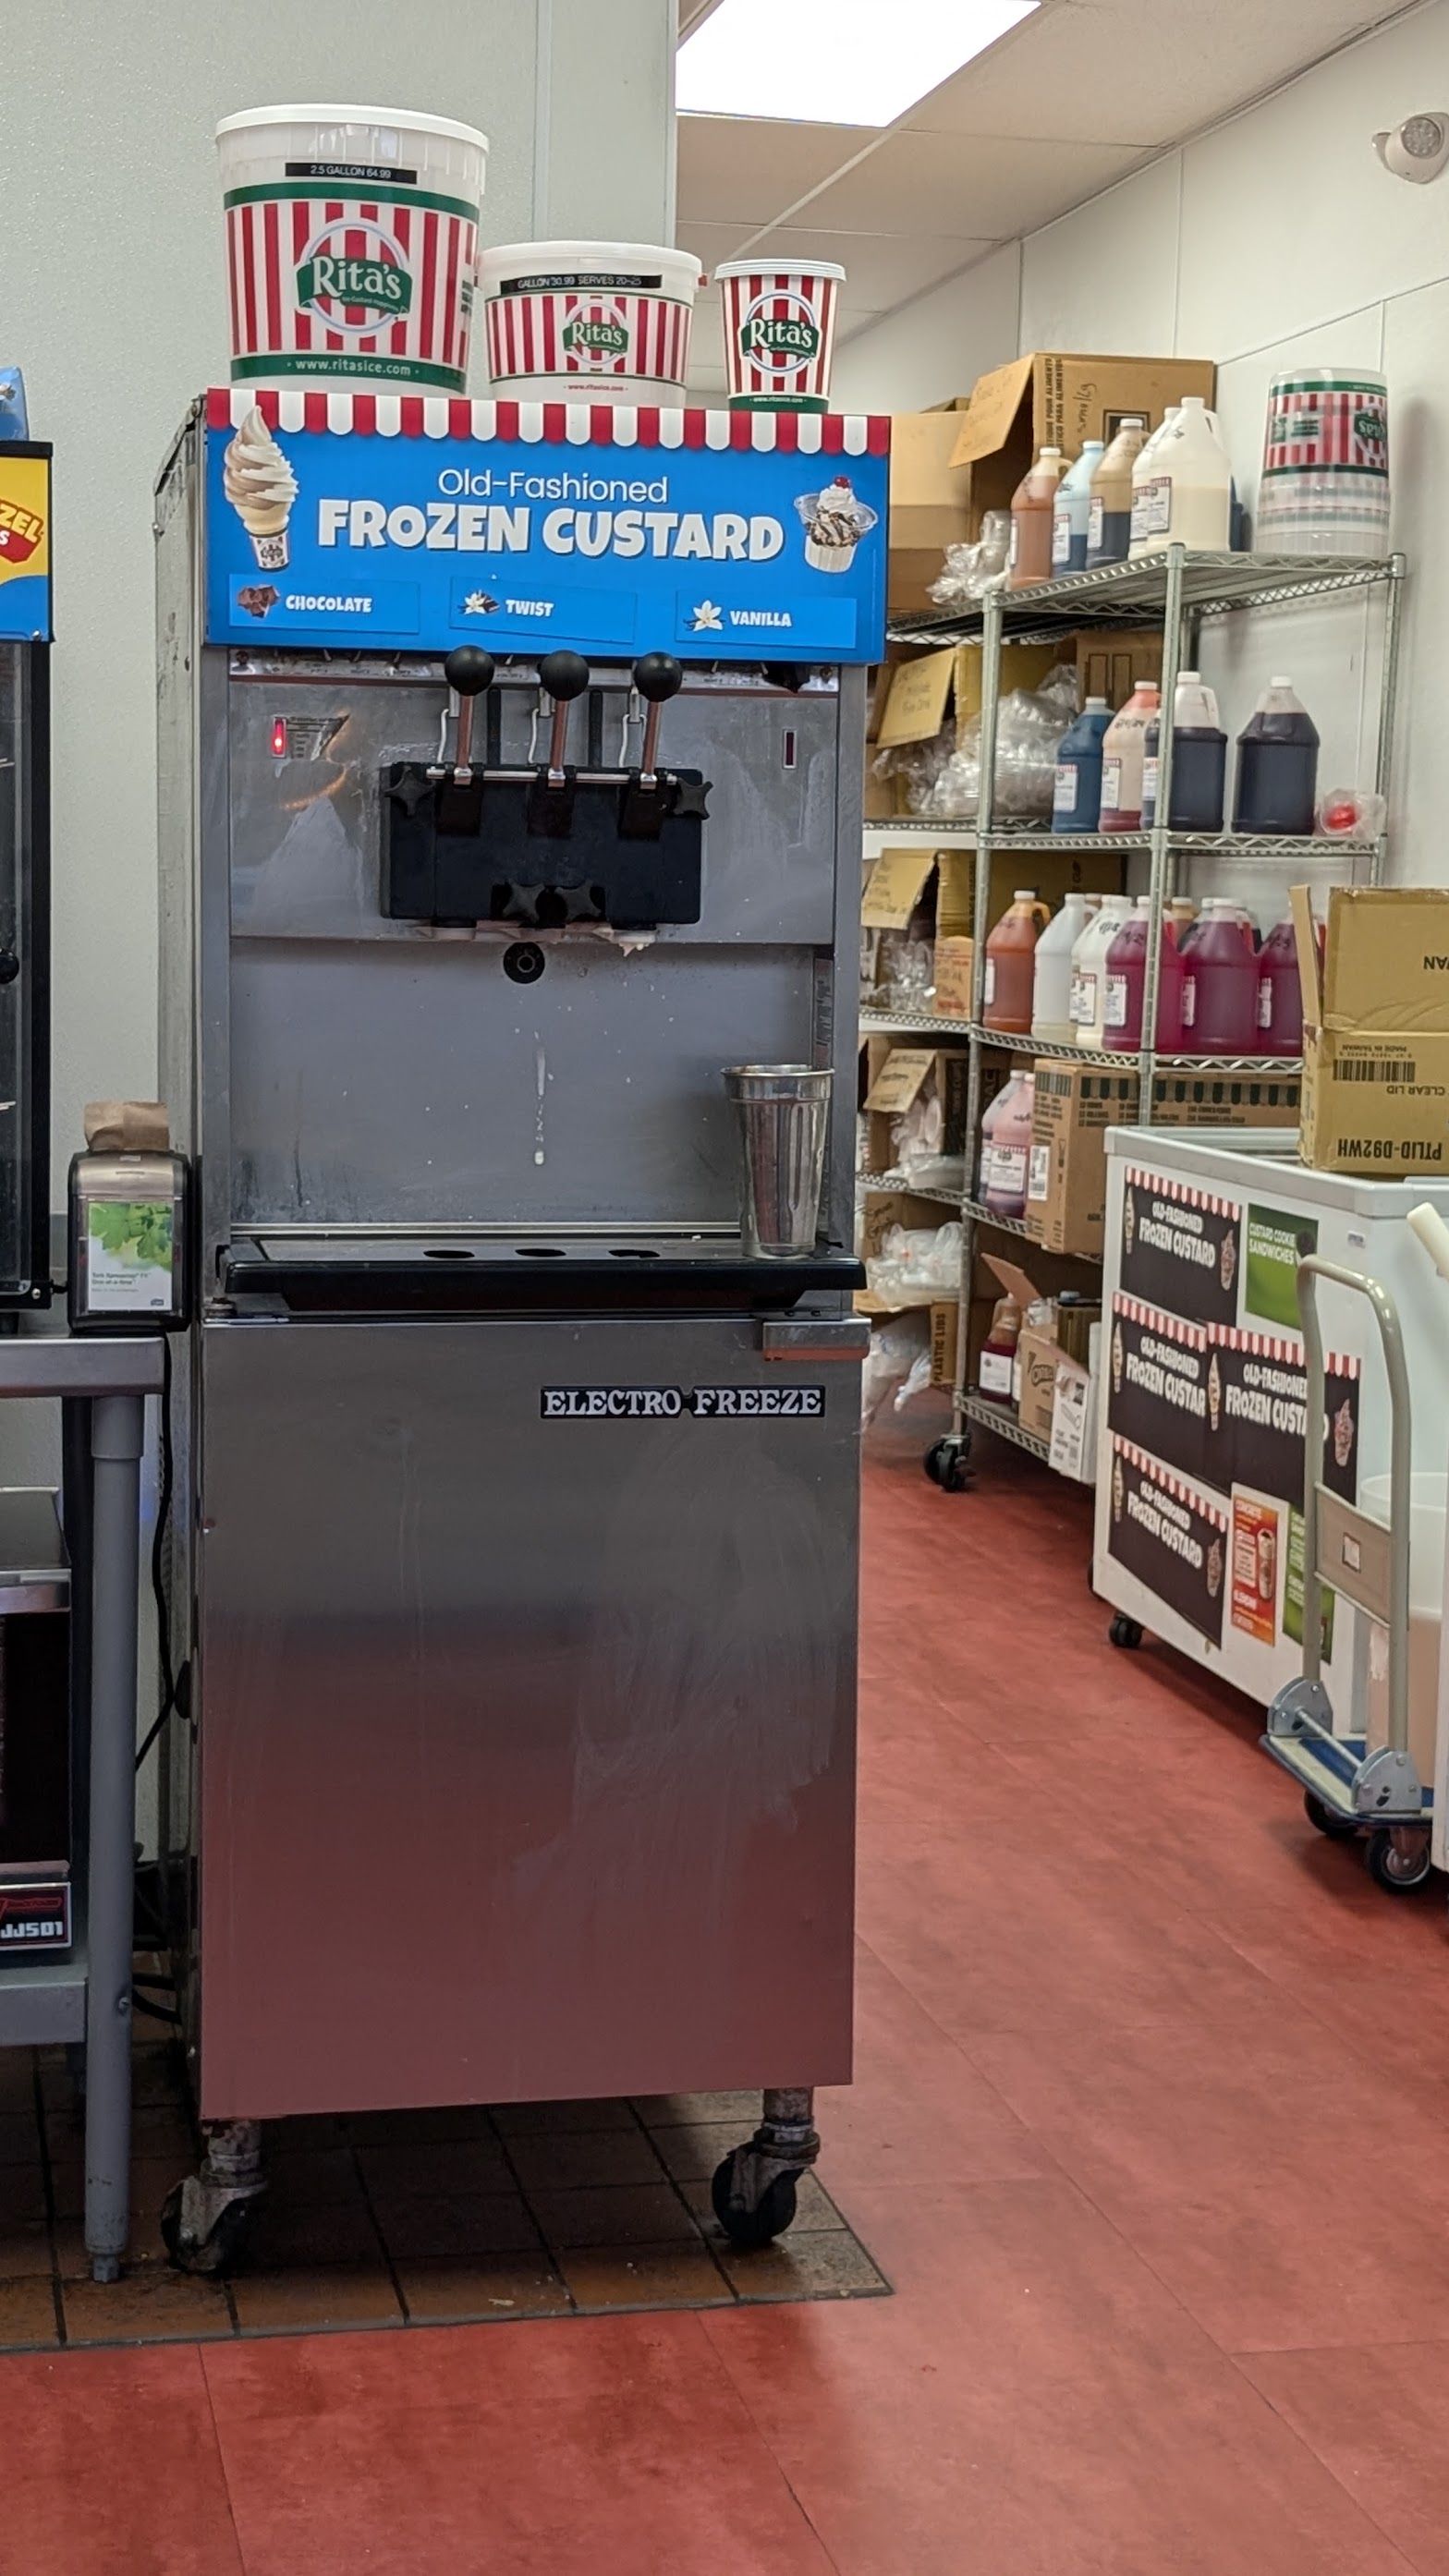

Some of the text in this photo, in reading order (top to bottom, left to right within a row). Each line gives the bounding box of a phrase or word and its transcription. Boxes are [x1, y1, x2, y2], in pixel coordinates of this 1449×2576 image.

[310, 164, 325, 176] 2.5
[326, 165, 365, 177] GALLON
[312, 255, 402, 300] Rita's
[518, 277, 550, 289] GALLON
[578, 274, 615, 286] SERVES
[572, 322, 624, 346] Rita's
[750, 318, 812, 348] Rita's
[295, 358, 411, 376] www.ritasice.com
[438, 468, 668, 503] Old-Fashioned
[318, 499, 785, 562] FROZEN CUSTARD
[285, 593, 372, 614] CHOCOLATE
[505, 599, 554, 619] TWIST
[729, 610, 793, 628] VANILLA
[1386, 1085, 1445, 1096] CLEAR LID
[1337, 1137, 1443, 1161] PTLID-D92WH
[1151, 1200, 1203, 1234] OLD-FASHIONED
[1138, 1216, 1216, 1269] FROZEN CUSTARD
[933, 1313, 946, 1382] PLASTIC LIDS
[1140, 1336, 1199, 1379] OLD-FASHIONED
[1126, 1352, 1206, 1418] FROZEN CUSTAR
[543, 1389, 822, 1416] ELECTRO FREEZE
[1225, 1384, 1272, 1427] FROZEN
[1127, 1490, 1203, 1568] FROZEN CUSTARD
